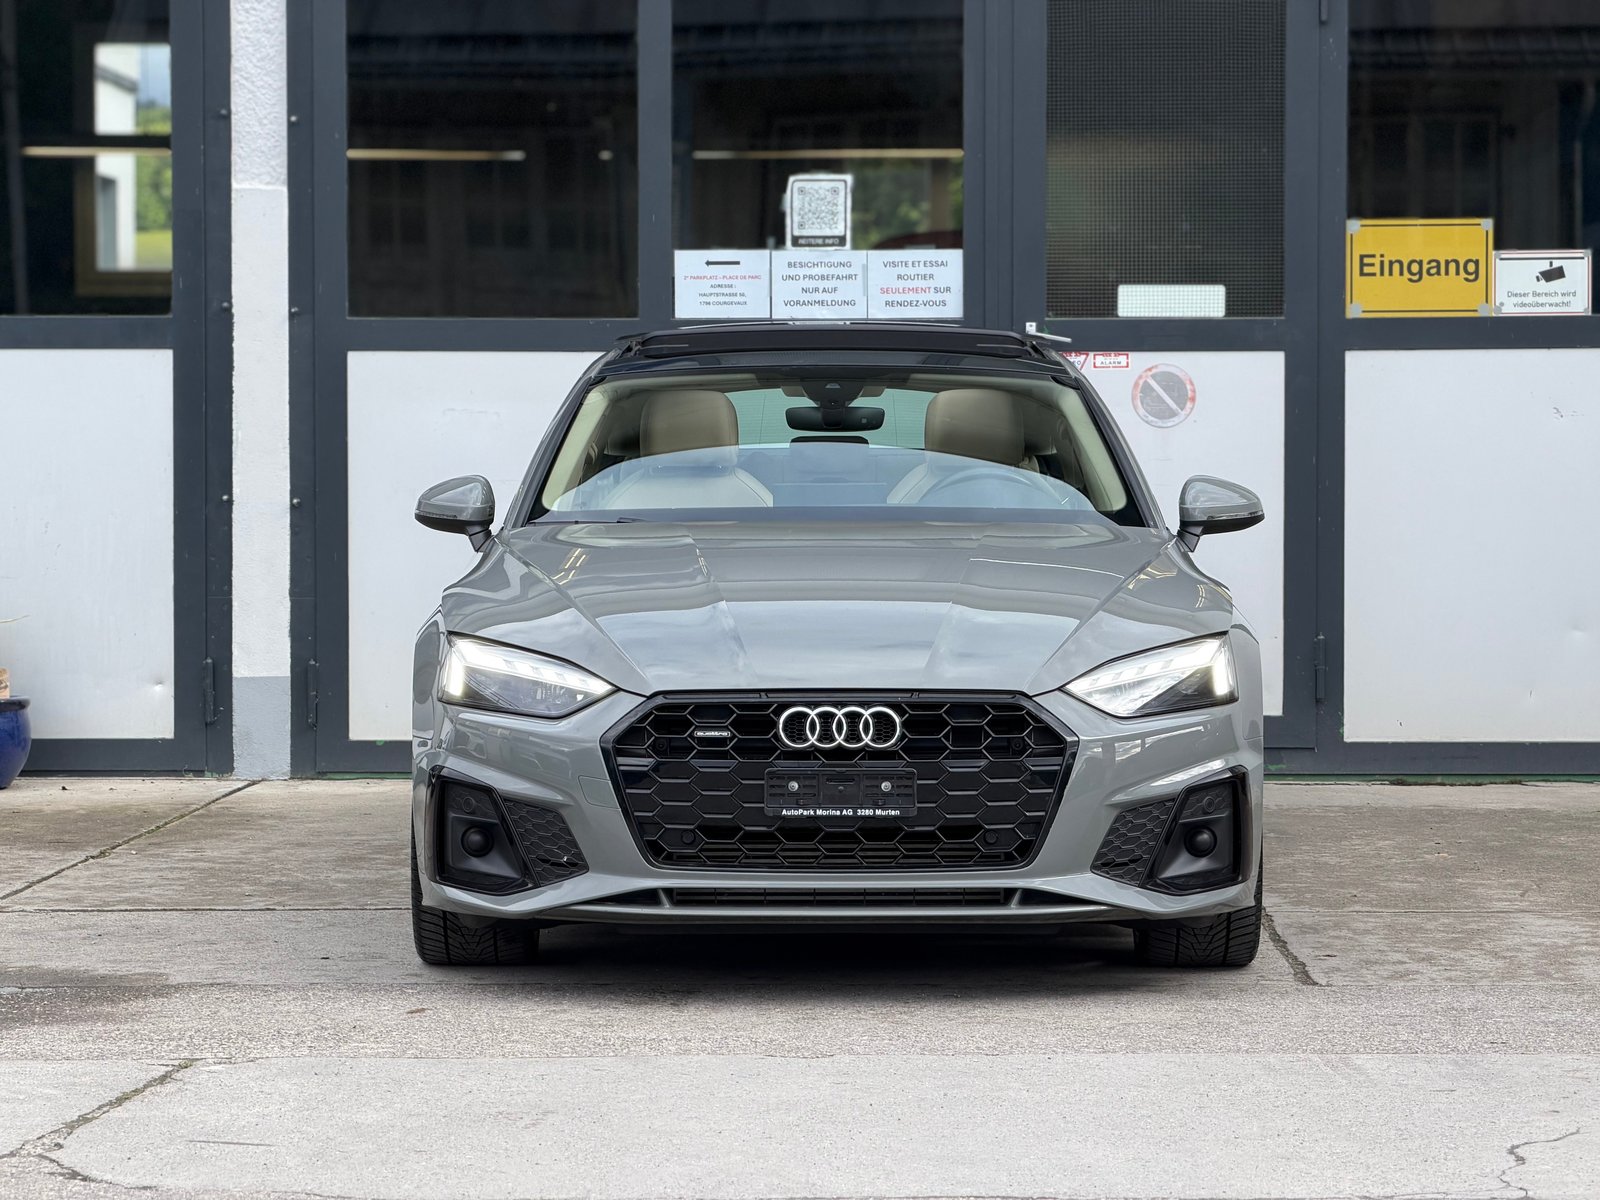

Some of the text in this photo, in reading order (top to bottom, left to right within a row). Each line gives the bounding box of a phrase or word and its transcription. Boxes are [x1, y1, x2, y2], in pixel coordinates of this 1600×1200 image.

[787, 260, 852, 268] BESICHTIGUNG
[923, 260, 948, 268] ESSAI
[1358, 254, 1480, 282] Eingang
[784, 299, 856, 307] VORANMELDUNG
